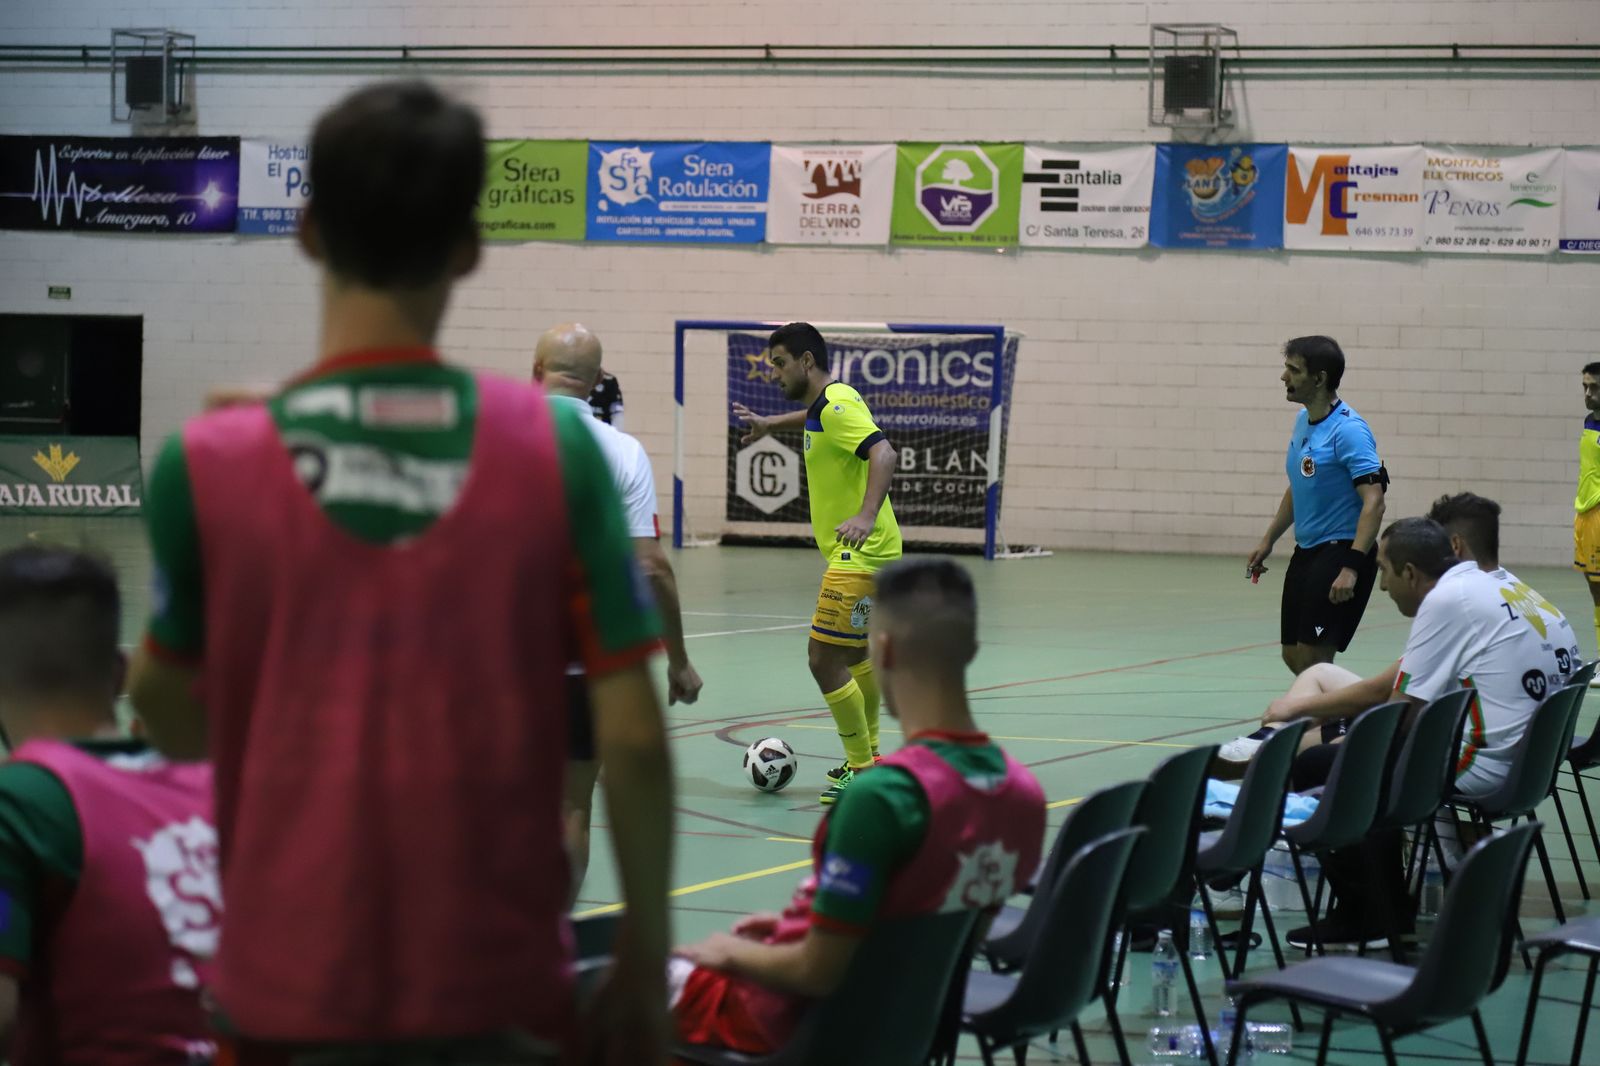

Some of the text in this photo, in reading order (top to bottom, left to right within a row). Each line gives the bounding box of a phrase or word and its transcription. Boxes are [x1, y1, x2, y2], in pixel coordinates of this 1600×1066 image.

[58, 144, 112, 162] Expertos
[115, 151, 128, 160] en
[268, 145, 309, 160] Hostal
[503, 157, 560, 182] Sfera
[683, 154, 734, 176] Sfera
[1428, 158, 1500, 168] MONTAJES
[267, 163, 312, 197] El Po
[1063, 170, 1122, 185] antalia
[1423, 170, 1504, 181] ELECTRICOS
[658, 176, 758, 198] Rotulación
[488, 184, 575, 208] gráficas
[801, 203, 860, 215] TIERRA
[86, 208, 196, 230] Amargura, 10
[1026, 225, 1145, 239] C/ Santa Teresa, 26
[1355, 227, 1414, 238] 646 95 73 39
[1435, 236, 1452, 246] 980
[1516, 238, 1527, 247] 40
[1529, 238, 1540, 247] 90
[1567, 241, 1600, 250] C/ DIEG
[901, 447, 988, 472] BLAN
[902, 481, 986, 494] DE COCIN
[0, 484, 141, 507] AJA RURAL
